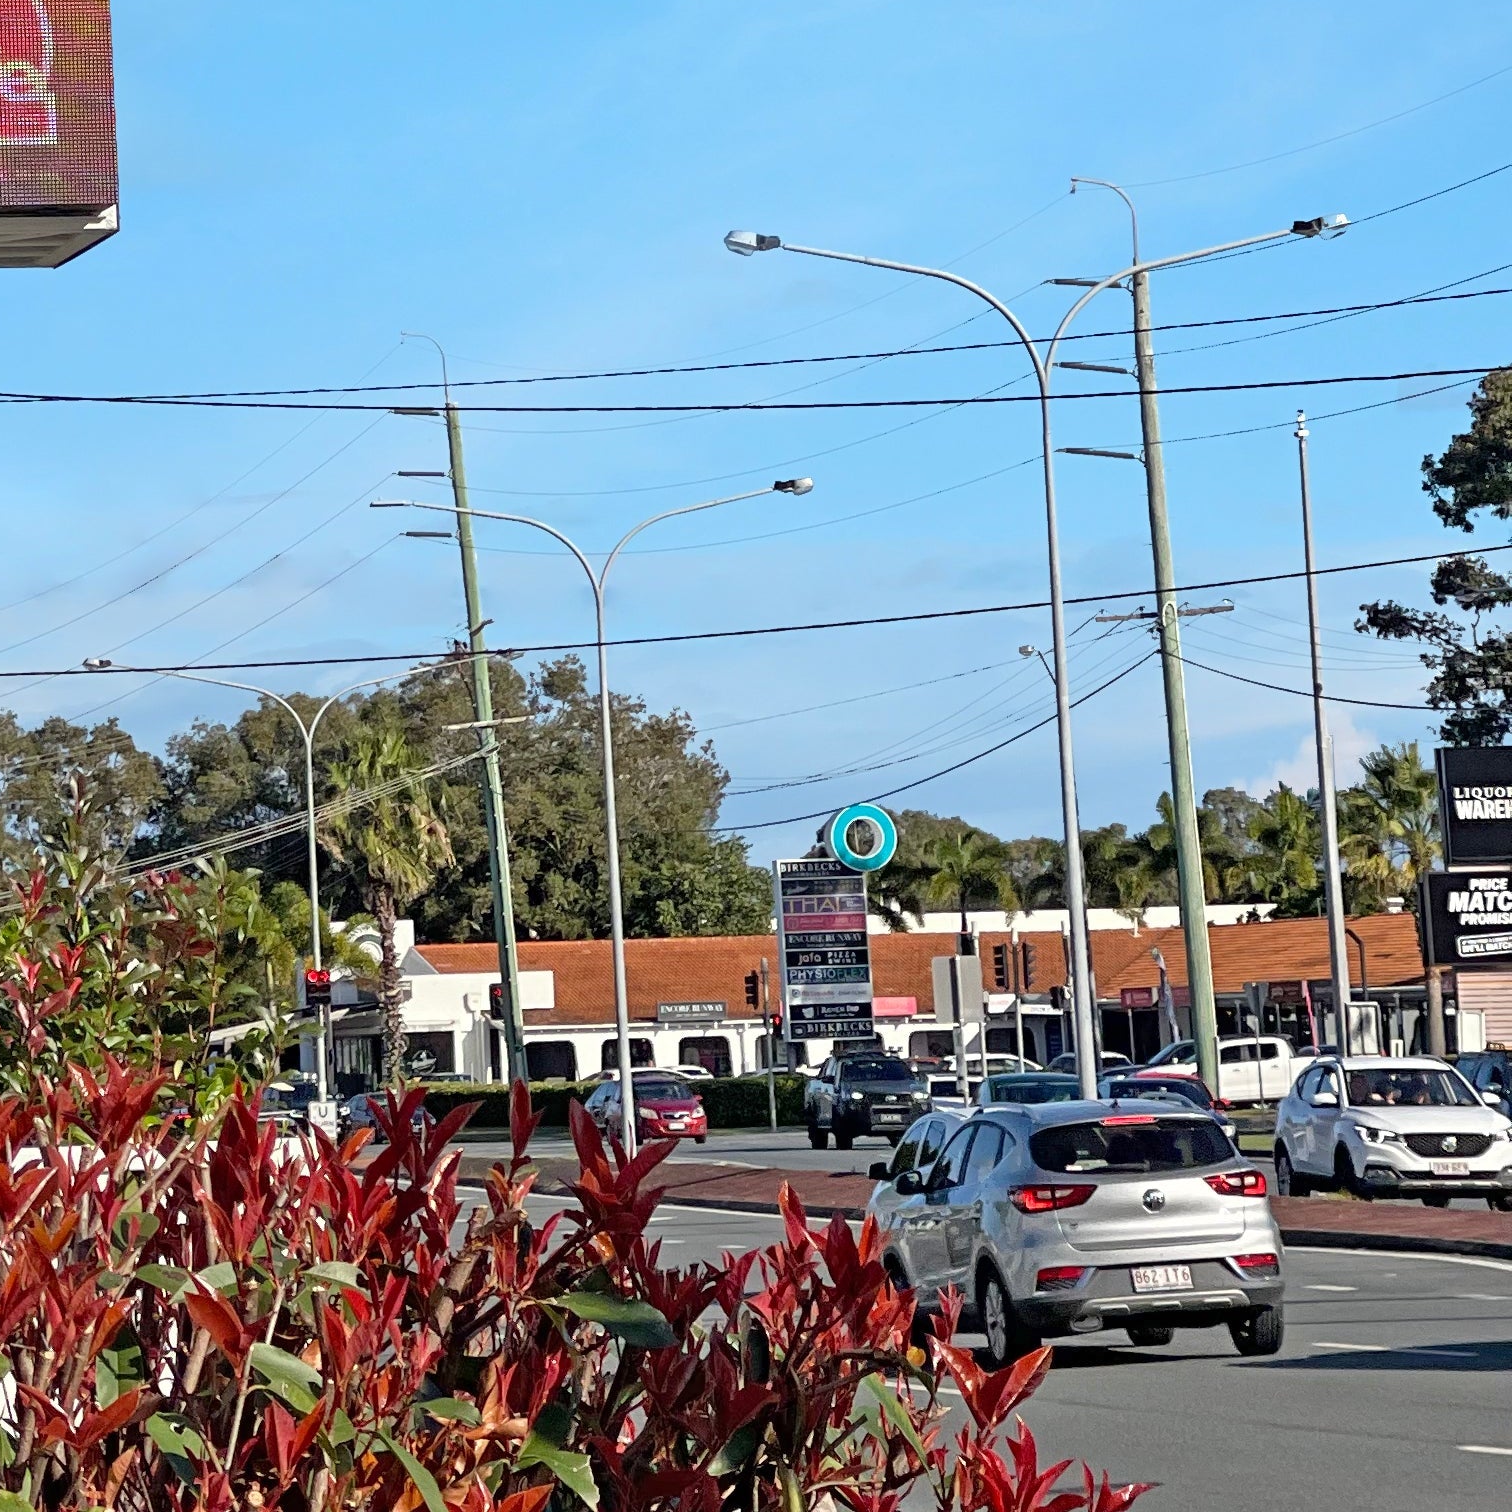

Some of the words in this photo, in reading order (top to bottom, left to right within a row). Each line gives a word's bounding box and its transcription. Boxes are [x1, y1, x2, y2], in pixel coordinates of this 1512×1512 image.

[780, 862, 842, 873] BIRKBECKS
[1469, 877, 1509, 891] PRICE
[782, 896, 841, 914] THAI
[789, 968, 866, 980] PHYSIOFLEX
[807, 1021, 872, 1034] BIRKBECKS
[1135, 1269, 1159, 1284] 862
